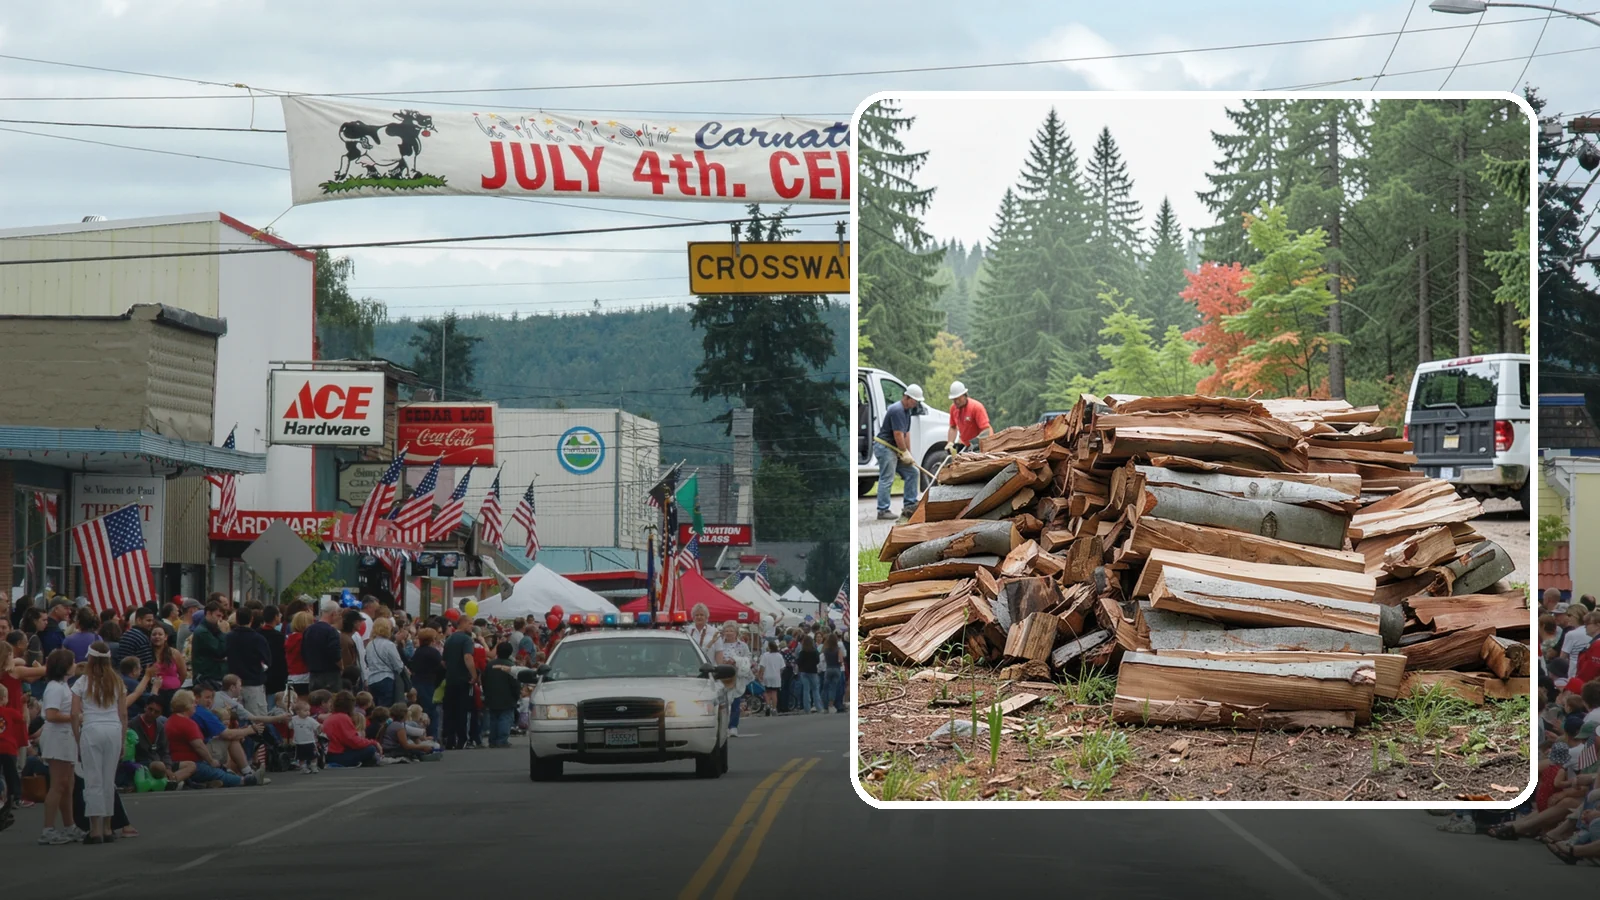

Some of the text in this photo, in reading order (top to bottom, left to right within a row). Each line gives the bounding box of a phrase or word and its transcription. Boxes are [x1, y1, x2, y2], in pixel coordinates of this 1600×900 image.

[481, 141, 605, 192] JULY
[632, 150, 747, 198] 4th.
[697, 254, 850, 280] CROSSWA
[282, 380, 374, 420] ACE
[405, 409, 485, 423] CEDAR LOG
[283, 421, 371, 436] Hardware
[96, 485, 124, 494] Vincent
[126, 486, 136, 494] de
[138, 486, 155, 495] Paul
[80, 503, 154, 521] THT
[212, 516, 331, 536] HARDARE
[688, 526, 742, 535] CRNATION
[699, 535, 731, 543] GLASS
